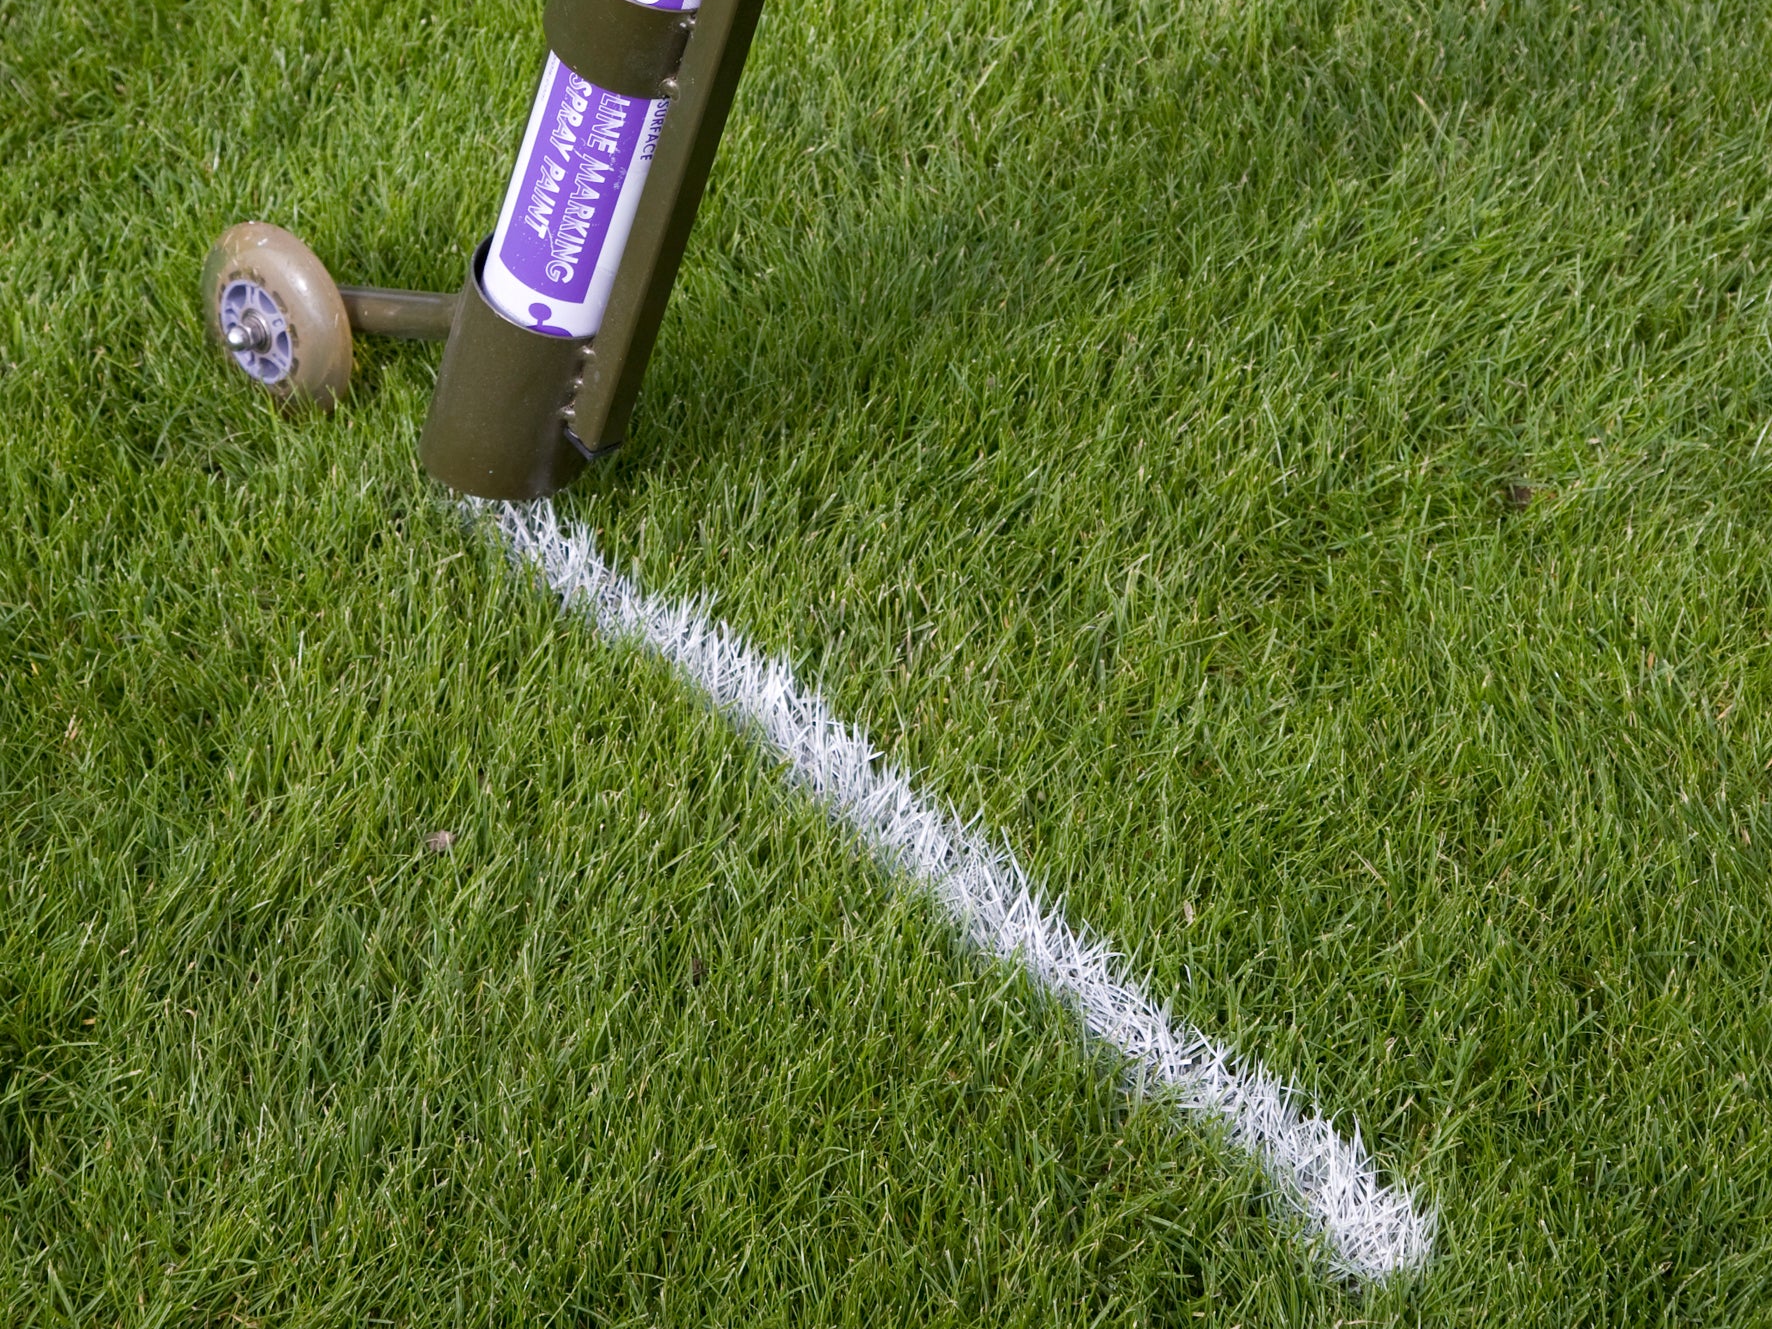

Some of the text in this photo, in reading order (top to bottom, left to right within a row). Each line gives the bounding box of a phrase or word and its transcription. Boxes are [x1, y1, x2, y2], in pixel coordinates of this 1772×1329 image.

[524, 72, 593, 240] SPRAY PAINT
[545, 92, 631, 283] LINE MARKING
